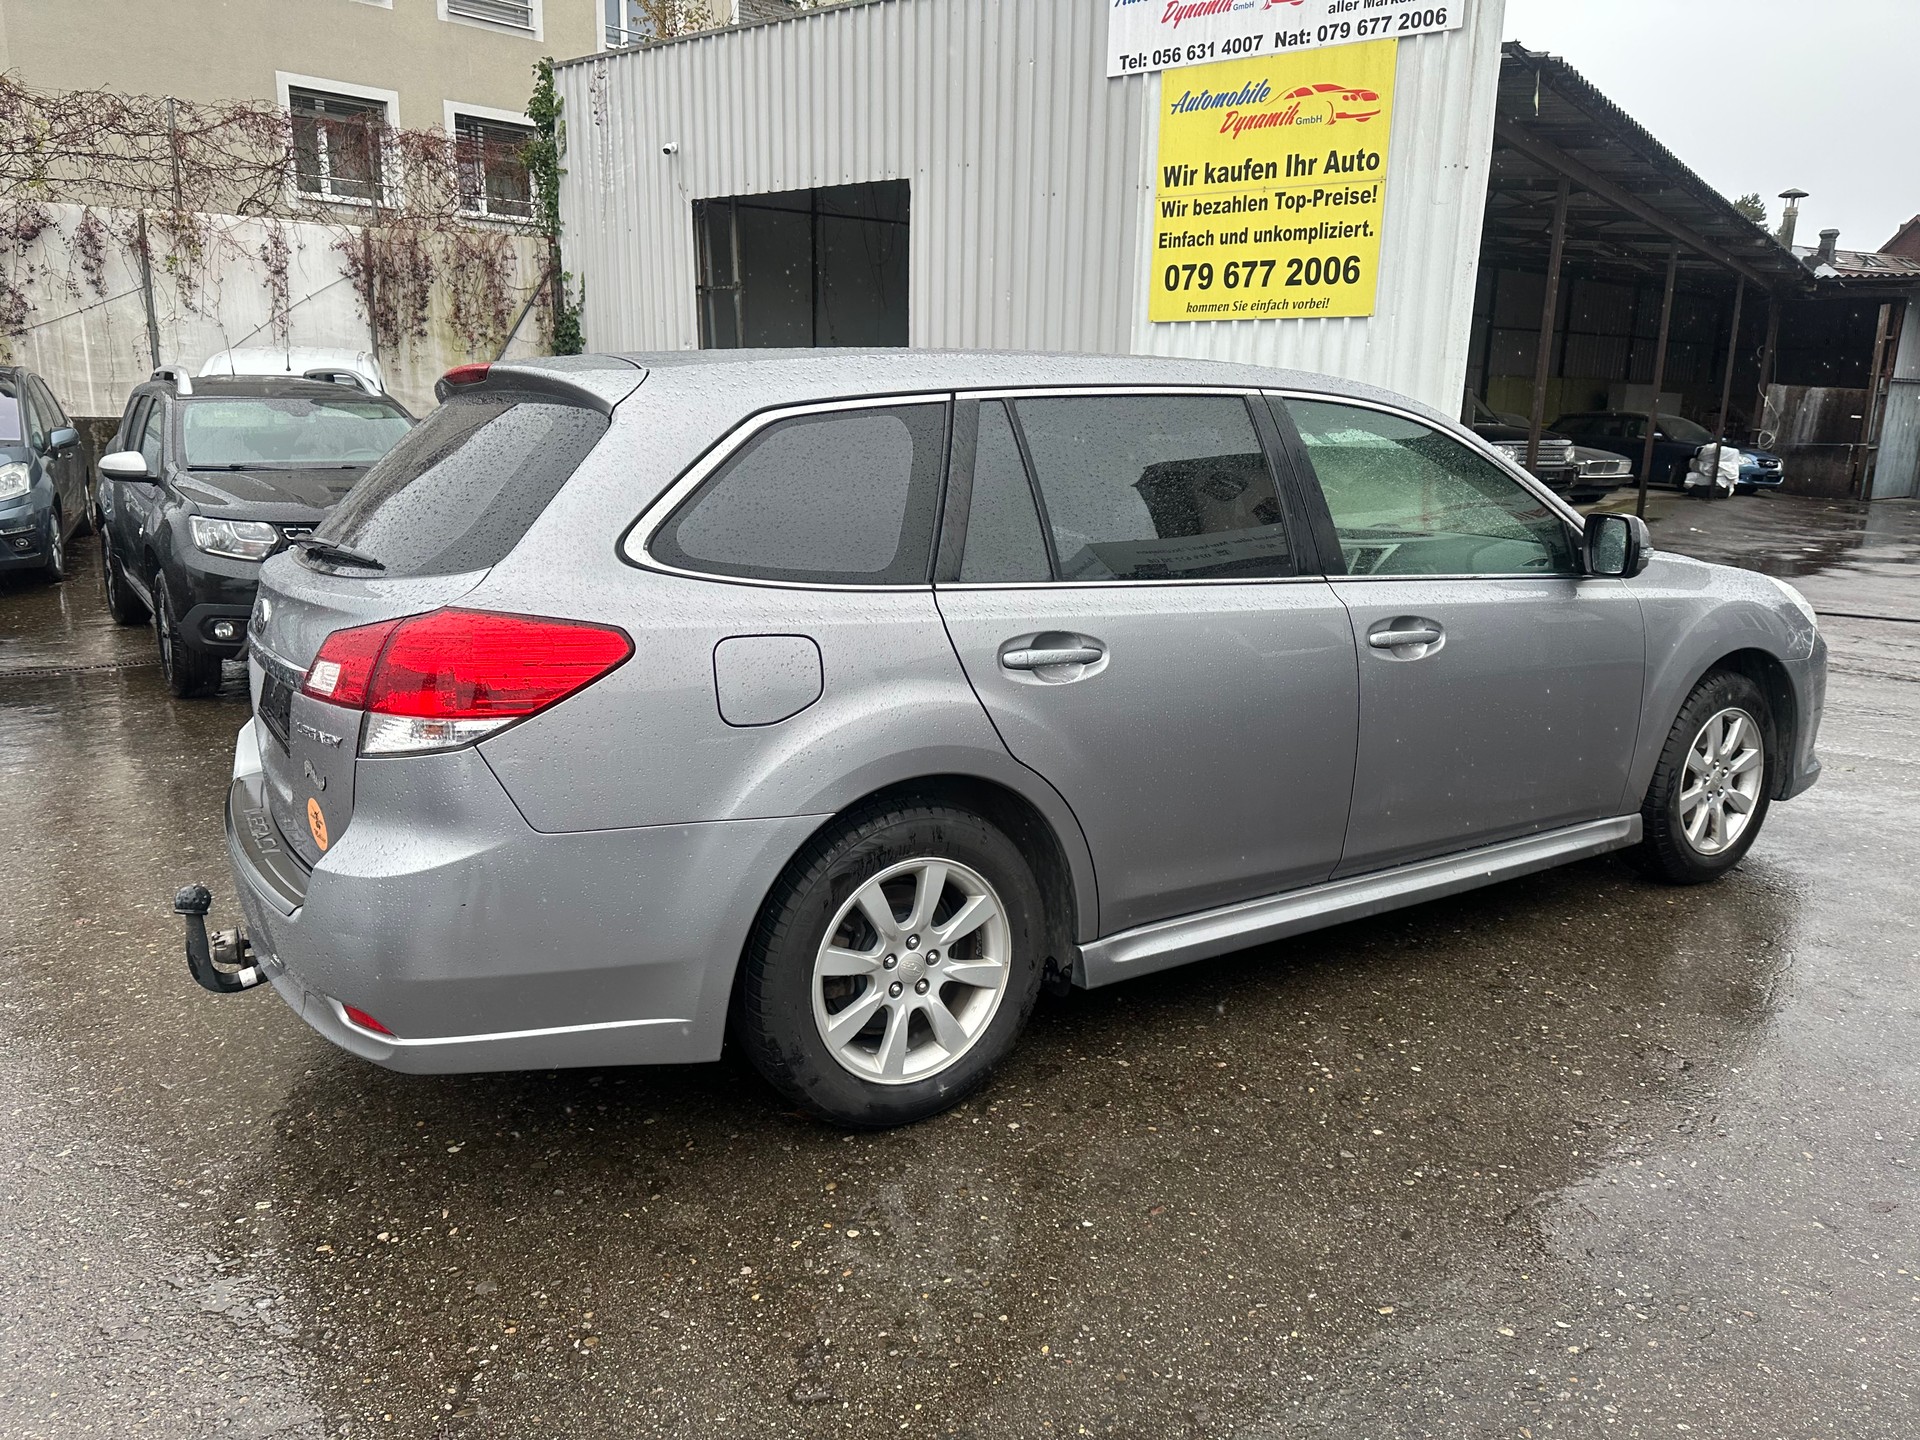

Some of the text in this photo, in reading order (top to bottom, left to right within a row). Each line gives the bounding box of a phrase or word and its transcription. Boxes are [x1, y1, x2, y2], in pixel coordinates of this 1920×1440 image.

[1233, 1, 1255, 11] GmbH
[1328, 0, 1416, 14] aller Mar
[1119, 7, 1447, 70] Tel: 056 631 4007 Nat: 079 677 2006
[1171, 78, 1271, 115] Automobile
[1219, 101, 1323, 140] Dynamik GmbH
[1163, 148, 1380, 188] Wir kaufen Ihr Auto
[1161, 185, 1378, 218] Wir bezahlen Top-Preise!
[1158, 220, 1374, 249] Einfach und unkompliziert.
[1164, 255, 1361, 292] 079 677 2006
[1186, 297, 1330, 313] kommen Sie einfach vorbei!
